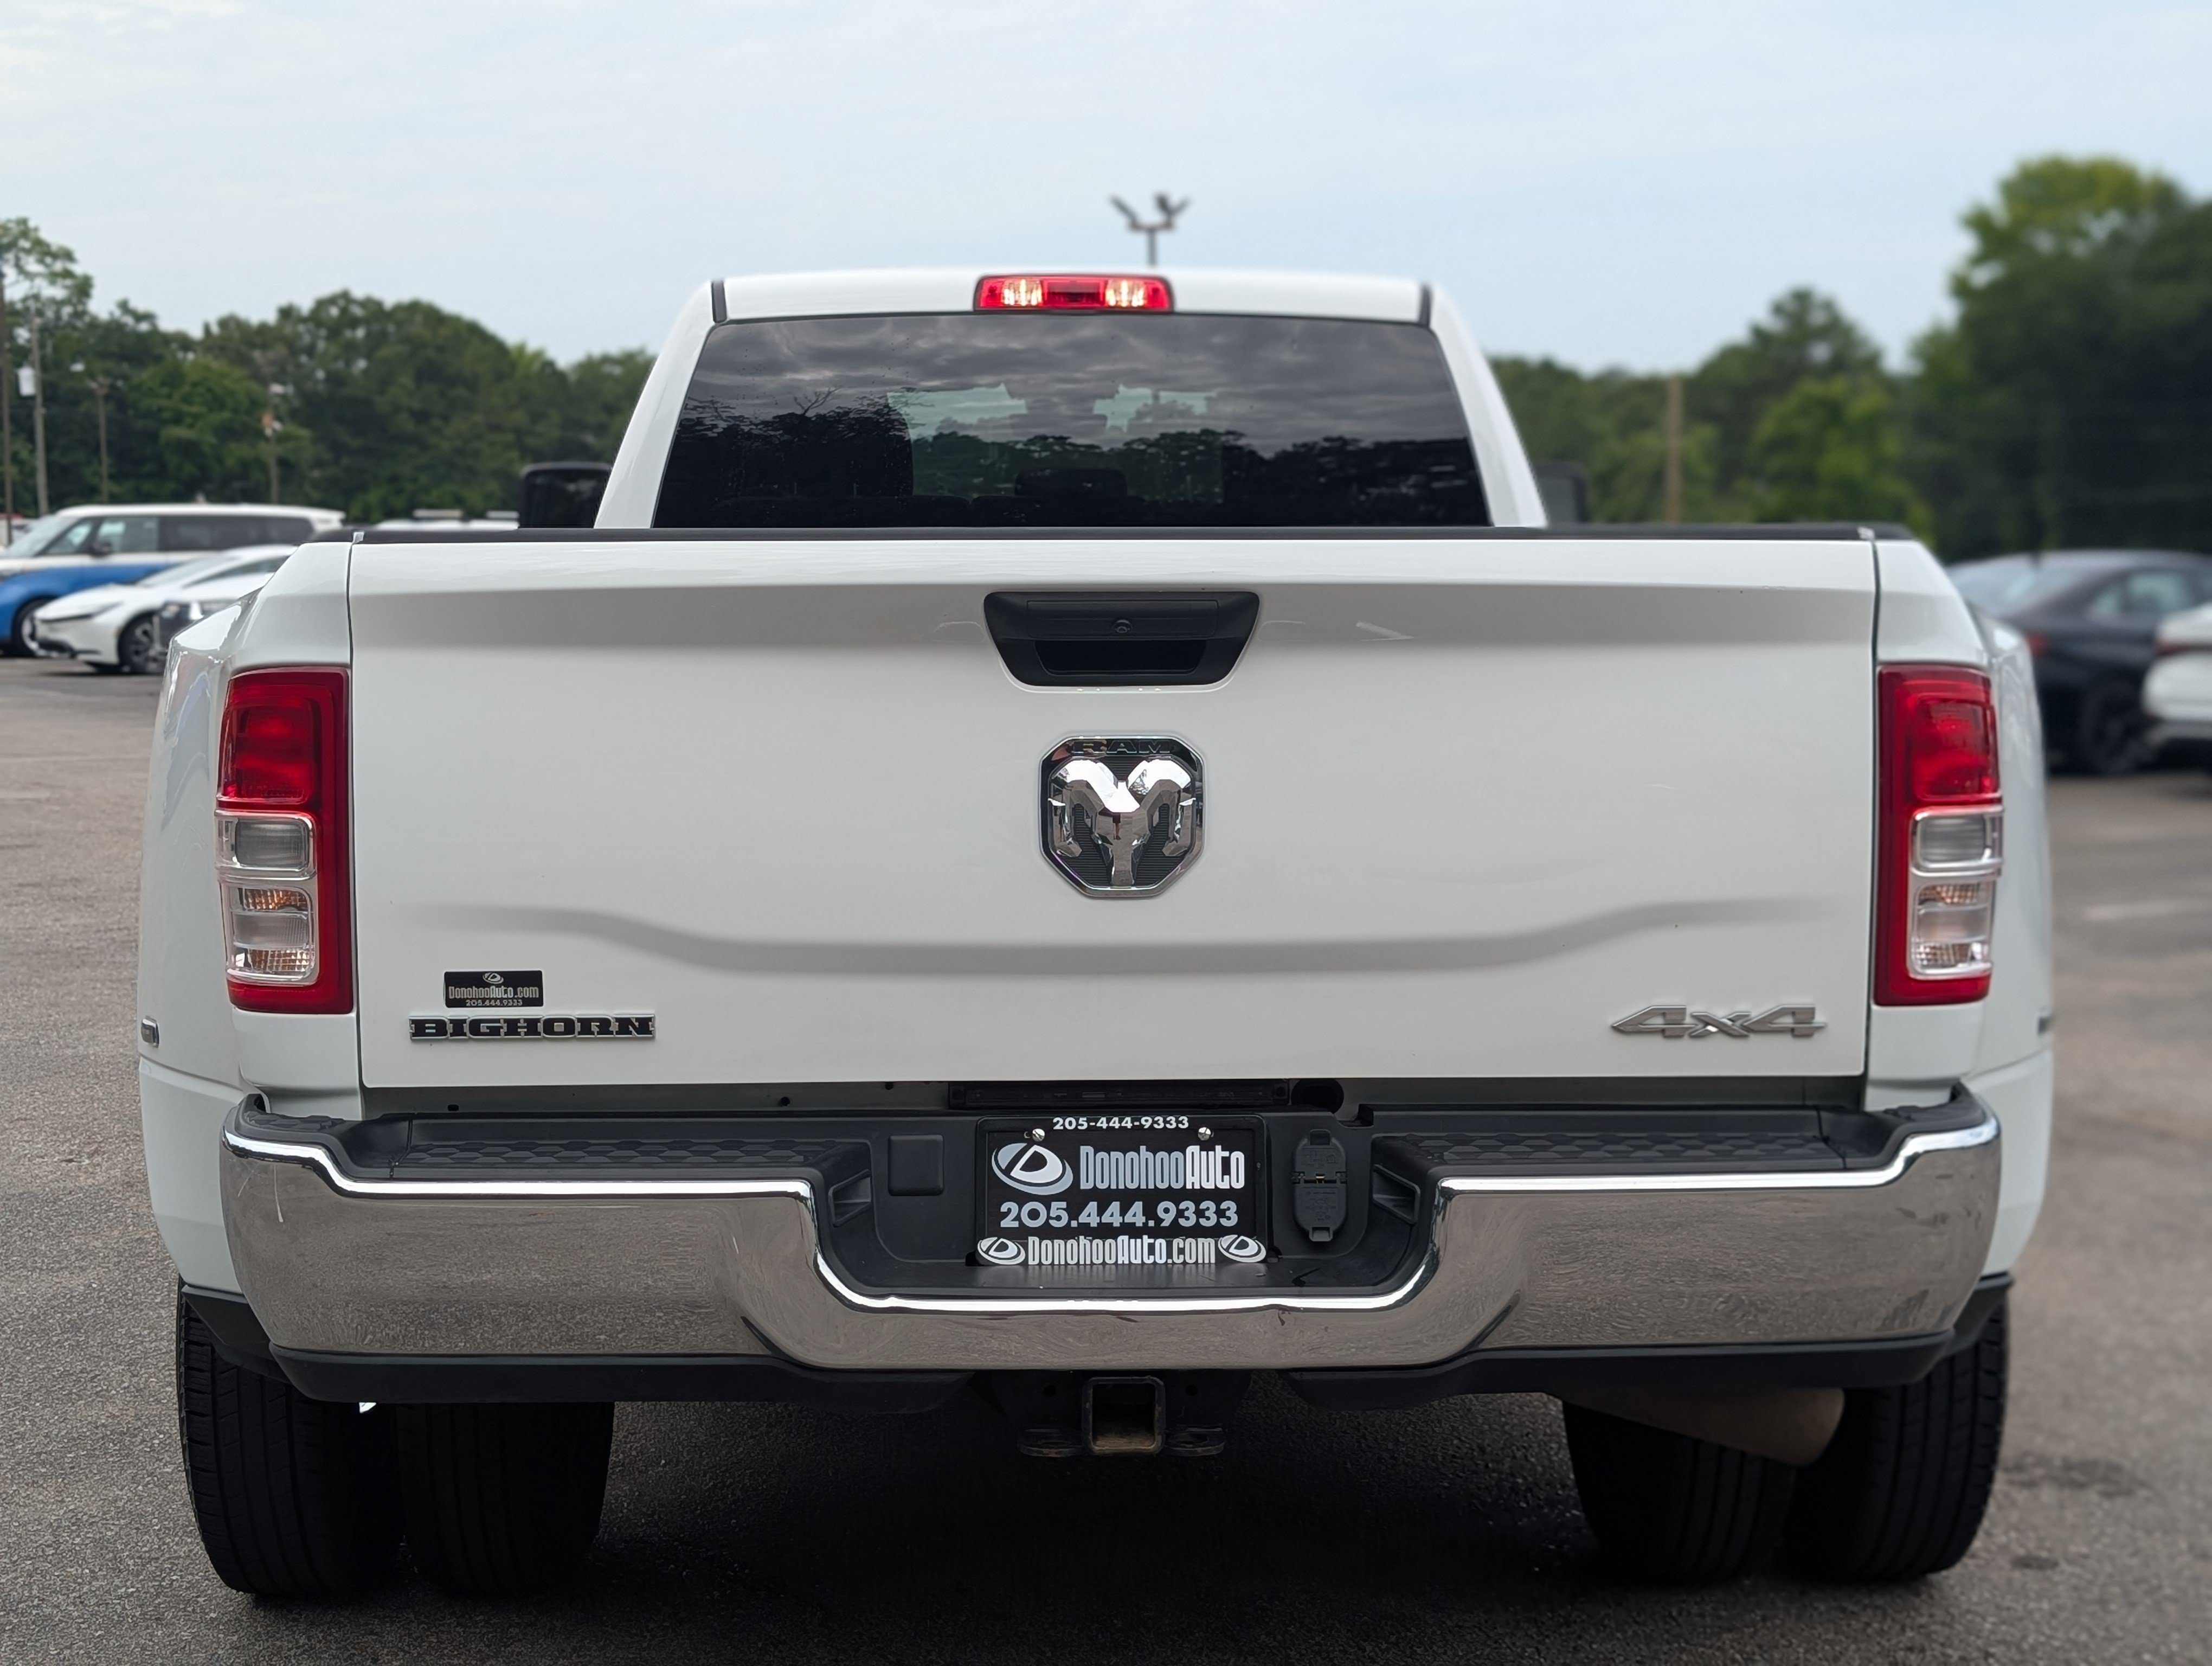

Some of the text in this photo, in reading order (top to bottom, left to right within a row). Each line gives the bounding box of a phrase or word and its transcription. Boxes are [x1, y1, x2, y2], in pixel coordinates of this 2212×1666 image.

[1071, 739, 1171, 754] RAM
[466, 999, 523, 1007] 205.444.9333
[409, 1014, 655, 1040] BIGHORN
[1053, 1116, 1189, 1130] 205-444-9333
[1080, 1145, 1245, 1189] DonohooAuto
[1000, 1200, 1239, 1228] 205.444.9333
[1028, 1234, 1216, 1265] DonohooAuto.com
